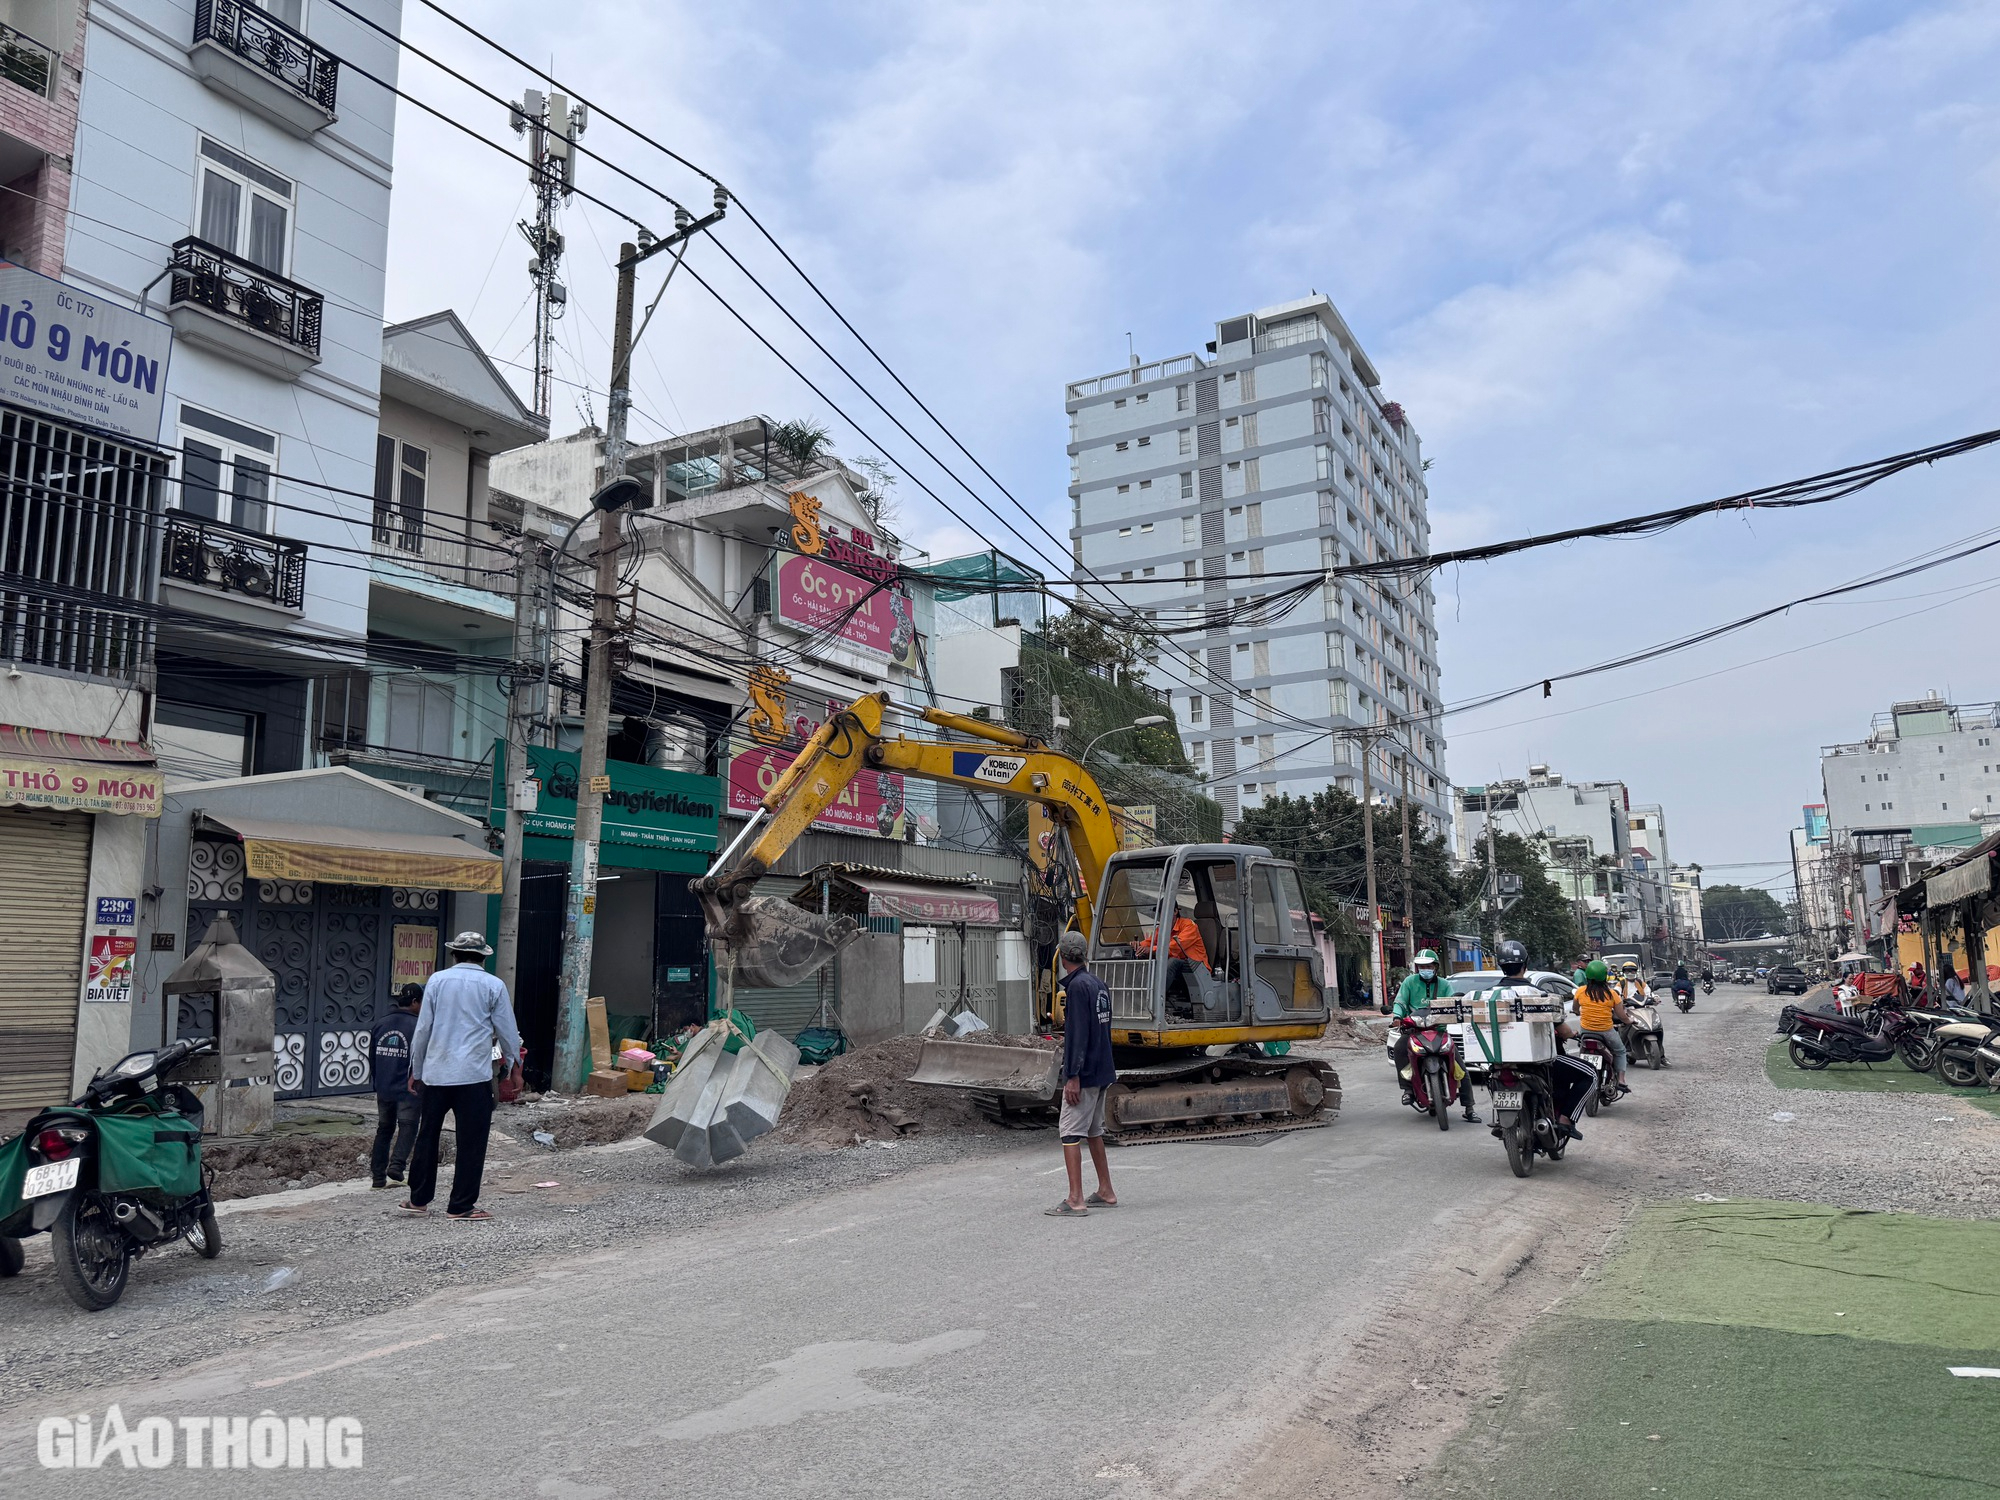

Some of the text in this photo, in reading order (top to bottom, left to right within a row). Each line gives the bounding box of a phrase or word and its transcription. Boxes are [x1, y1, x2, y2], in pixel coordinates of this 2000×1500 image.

[57, 291, 94, 318] ỐC 173
[47, 323, 71, 362] 9
[81, 334, 159, 395] MÓN
[4, 356, 24, 370] ĐUÔI
[26, 364, 37, 374] BÒ
[44, 370, 65, 385] TRÂU
[66, 380, 94, 394] NHÚNG
[112, 394, 128, 406] LẨU
[129, 400, 139, 410] GÀ
[14, 376, 110, 415] CÁC MÓN NHẬU BÌNH DÂN
[10, 390, 19, 398] 173
[20, 394, 38, 406] Hoàng
[110, 422, 120, 432] Tân
[852, 528, 874, 550] BIA
[800, 562, 827, 598] ỐC
[832, 583, 842, 604] 9
[792, 593, 802, 604] ỐC
[808, 600, 818, 610] HẢI
[856, 630, 868, 641] THỎ
[982, 767, 1010, 778] Yutani
[988, 760, 1018, 770] KOBELCO
[2, 768, 155, 800] THỎ 9 MÓN
[16, 791, 25, 800] 173
[44, 795, 54, 803] HOA
[736, 790, 746, 803] ỐC
[826, 806, 834, 817] ĐỒ
[865, 813, 874, 824] THỎ
[532, 820, 544, 828] CỤC
[546, 820, 567, 830] HOÀNG
[100, 899, 132, 912] 239C
[923, 902, 934, 916] 9
[940, 901, 968, 918] TÀI
[116, 914, 132, 922] 173
[152, 934, 172, 946] 175
[398, 930, 433, 948] CHO THUÊ
[396, 956, 419, 976] PHÒNG
[88, 988, 104, 1000] BIA
[1498, 1092, 1518, 1100] 59-P1
[36, 1161, 70, 1180] 68-T1
[28, 1175, 73, 1196] 029.14
